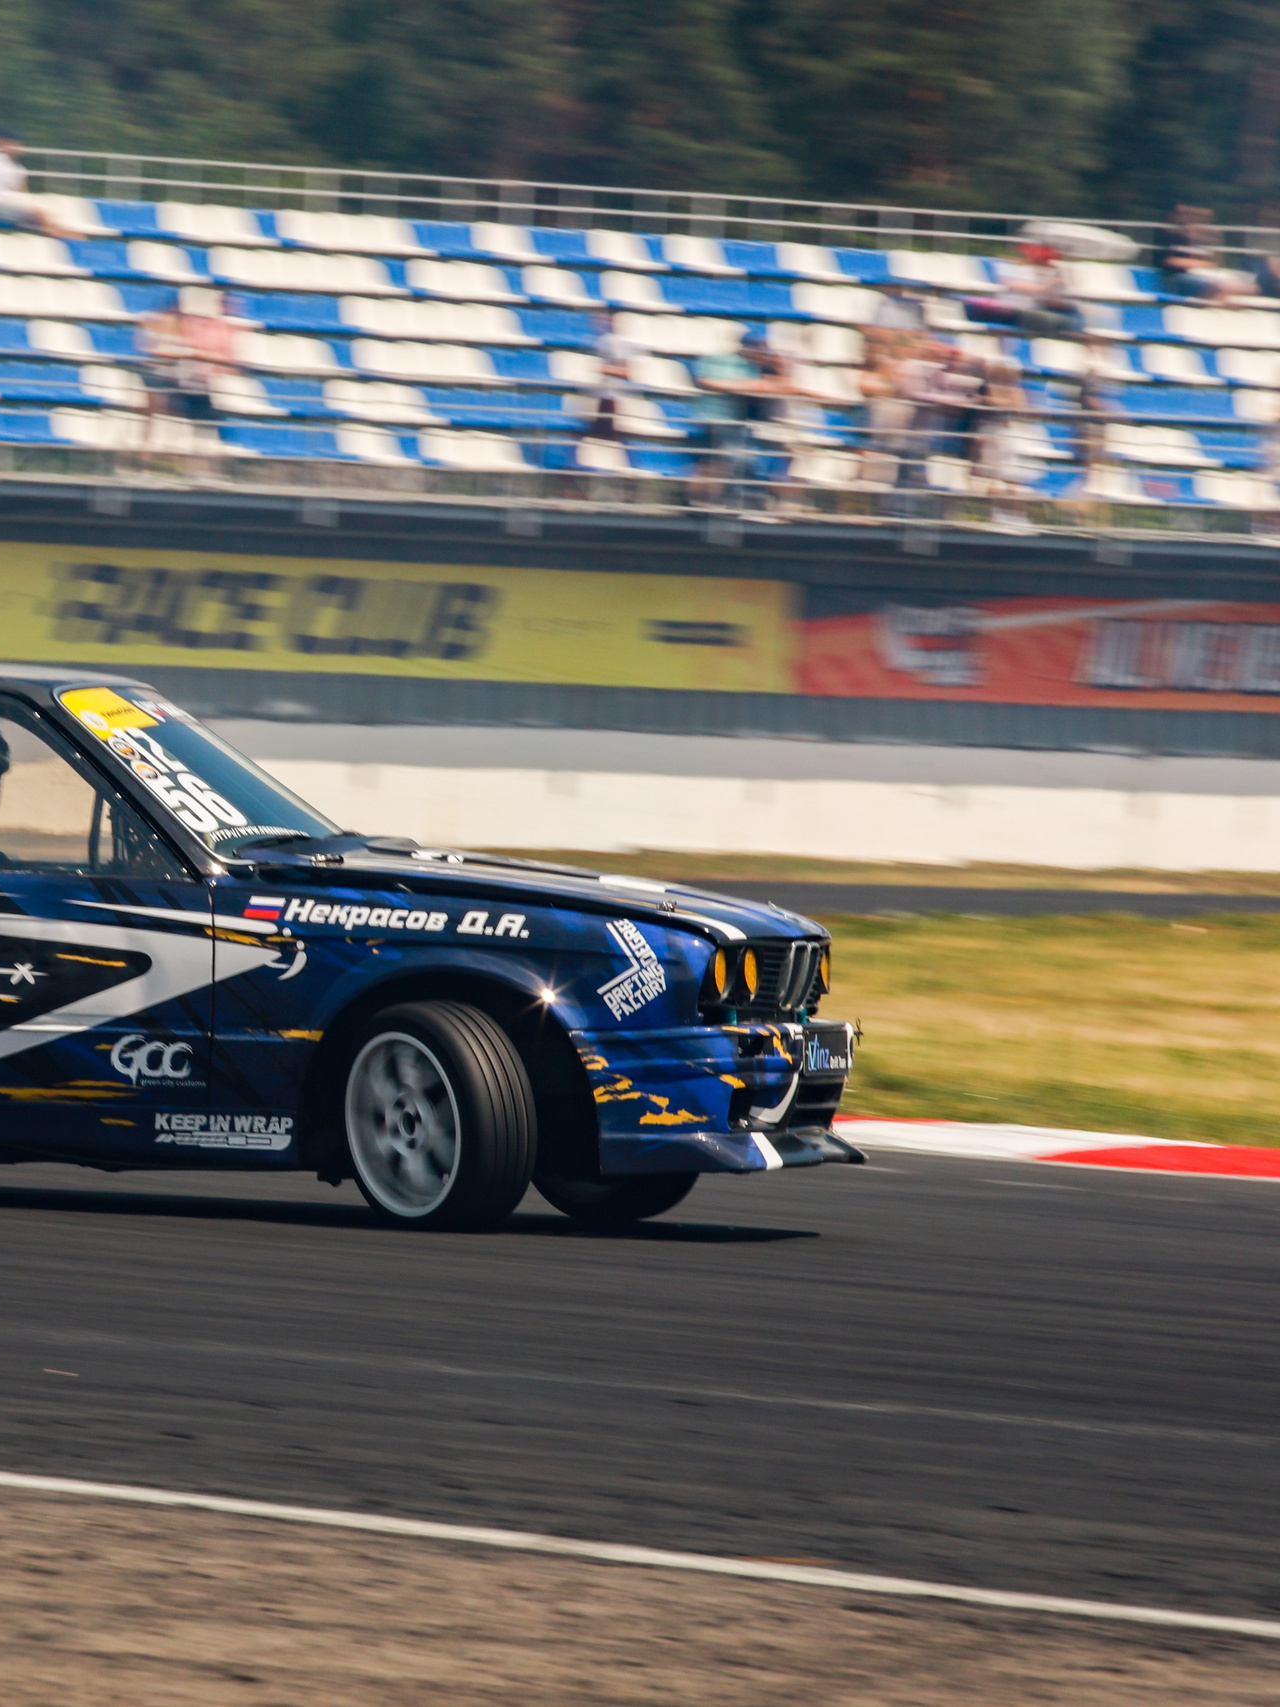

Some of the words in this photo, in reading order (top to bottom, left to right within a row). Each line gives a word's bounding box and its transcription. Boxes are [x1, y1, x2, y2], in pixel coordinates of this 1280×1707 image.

[111, 726, 190, 774] 12
[148, 772, 248, 833] 56
[284, 898, 448, 931] Некрасов
[456, 911, 530, 938] Д.А.
[603, 963, 665, 1010] DRIFTING
[612, 974, 667, 1022] FACTORY
[154, 1112, 208, 1130] KEEP
[209, 1114, 232, 1132] IN
[233, 1114, 294, 1134] WRAP
